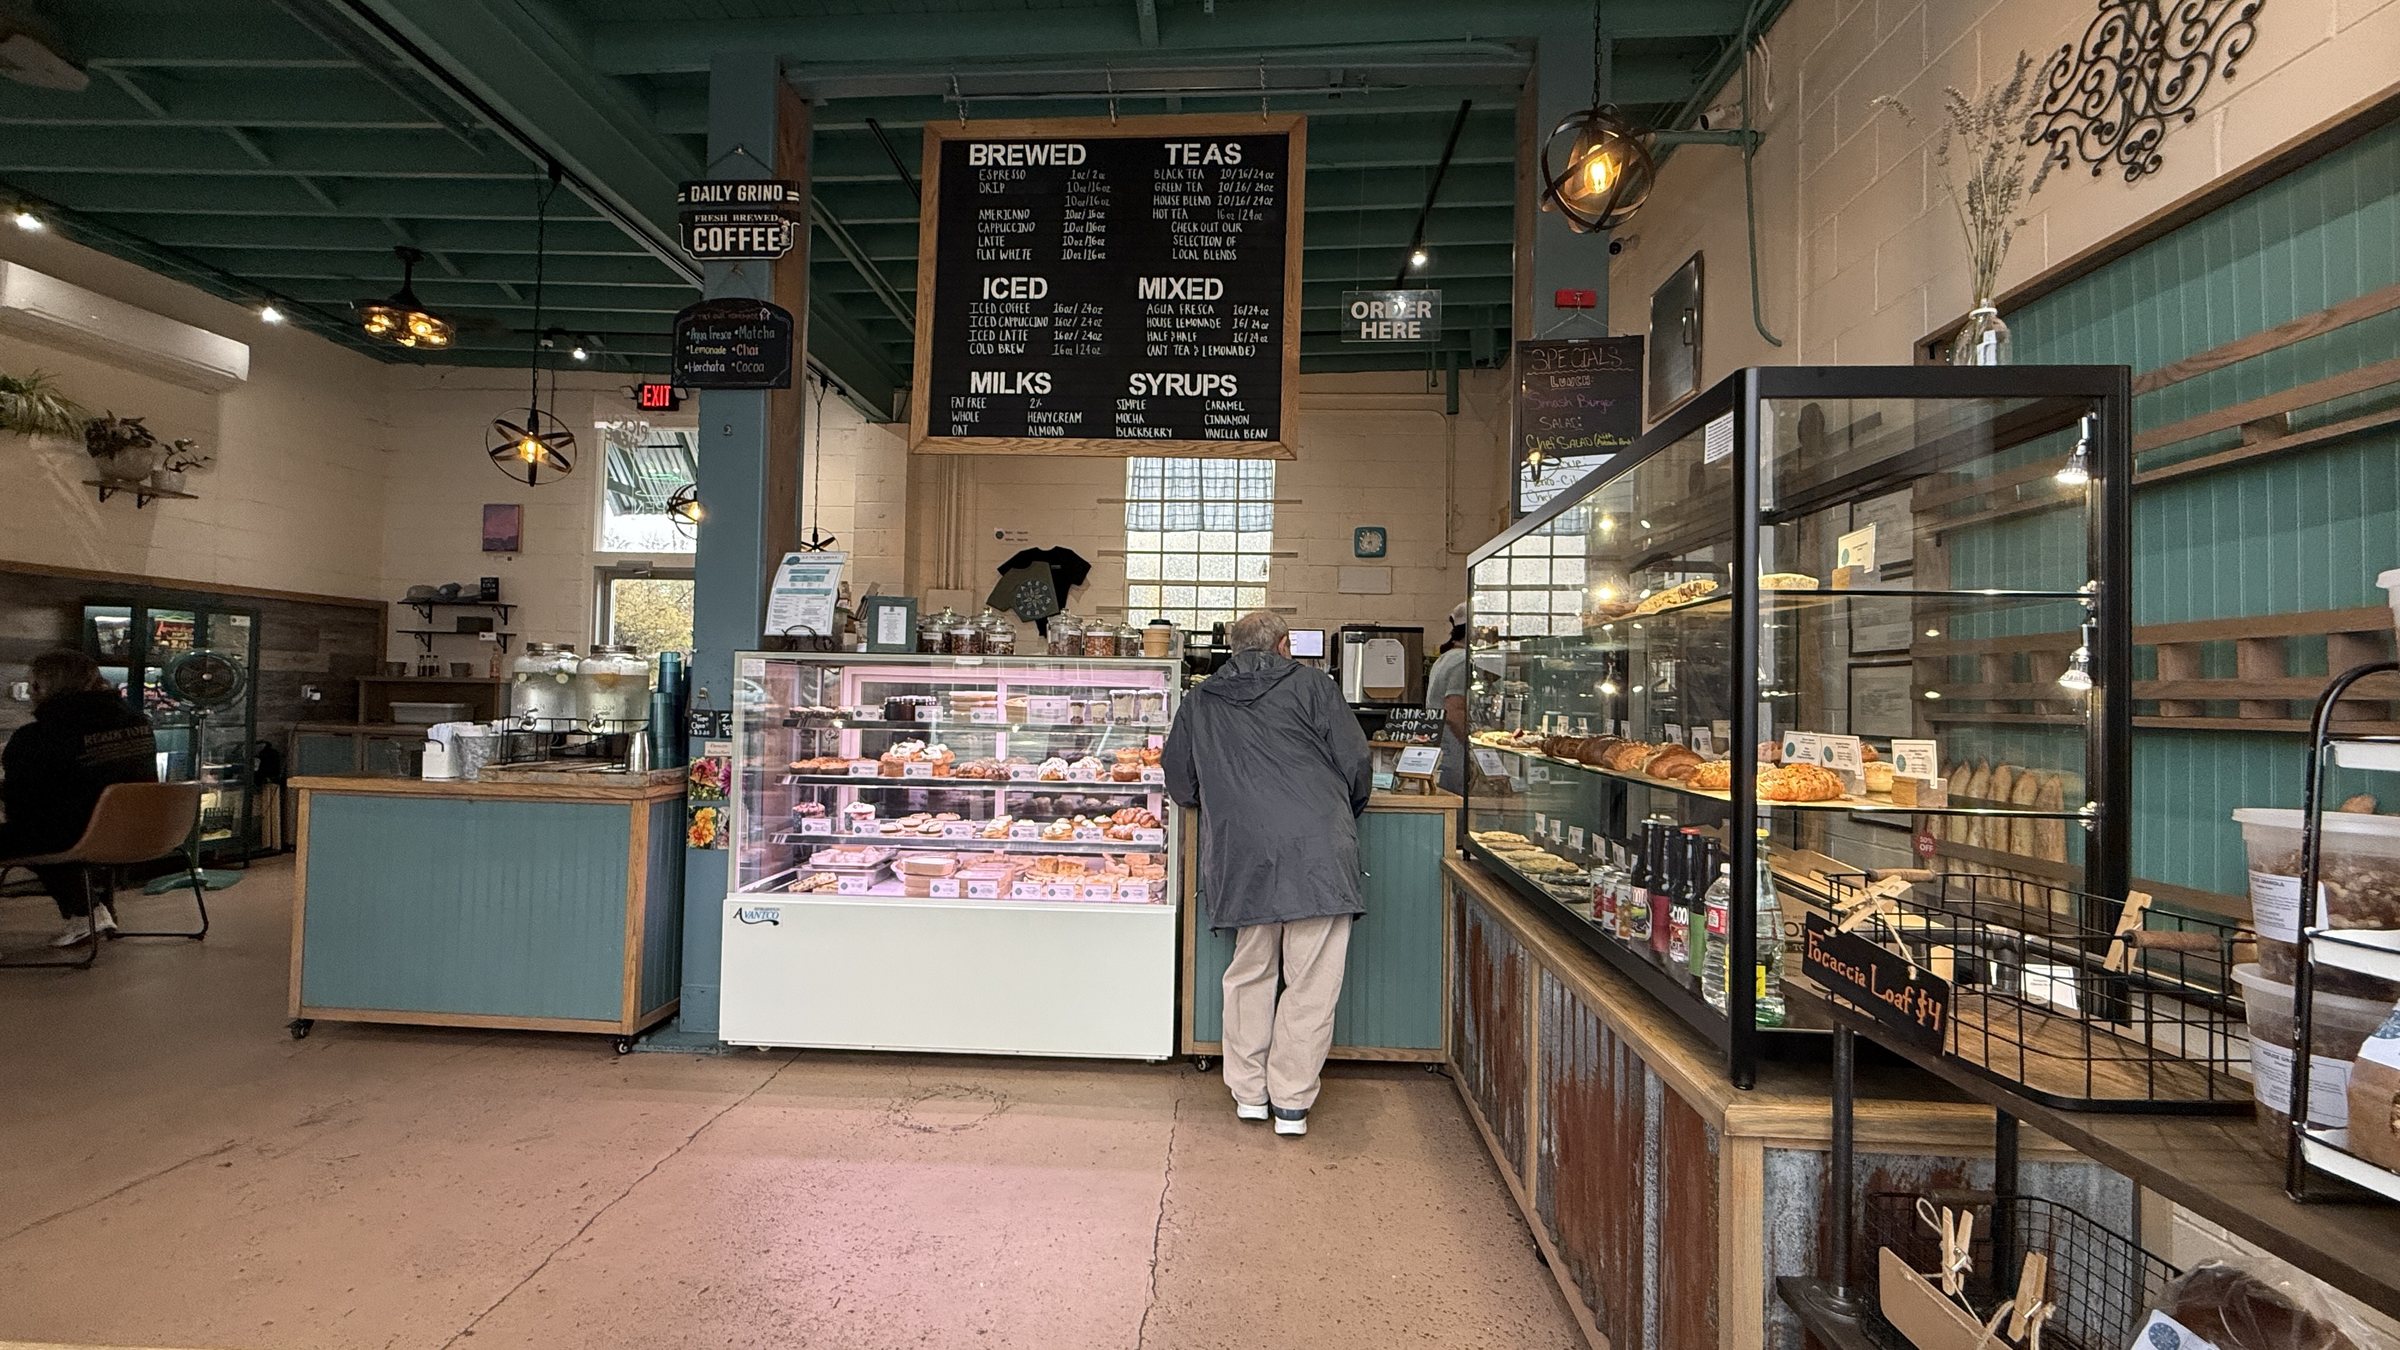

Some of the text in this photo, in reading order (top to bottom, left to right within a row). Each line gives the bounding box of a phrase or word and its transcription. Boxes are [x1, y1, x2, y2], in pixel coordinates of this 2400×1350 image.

[969, 144, 1086, 166] BREWED
[1164, 143, 1242, 165] TEAS
[979, 169, 1026, 180] ESPRESSO
[1154, 169, 1205, 180] BLACK TEA
[979, 182, 1005, 193] DRIP
[1154, 182, 1203, 192] GREEN TEA
[691, 185, 783, 202] DAILY GRIND
[1153, 195, 1211, 207] HOUSE BLEND
[695, 214, 778, 223] FRESH BREWED
[979, 209, 1030, 220] AMERICANO
[1152, 208, 1188, 219] HOT TEA
[978, 222, 1035, 234] CAPPUCCINO
[1171, 221, 1243, 233] CHECK OUT OUR
[693, 227, 780, 252] COFFEE
[978, 235, 1005, 247] LATTE
[1173, 235, 1237, 247] SELECTION OF
[977, 249, 1032, 260] FLAT WHITE
[1172, 248, 1237, 260] LOCAL BLENDS
[983, 277, 1048, 300] ICED
[1139, 277, 1224, 300] MIXED
[969, 303, 1030, 314] ICED COFFEE
[1146, 304, 1214, 315] AGUA FRESCA
[1351, 301, 1432, 319] ORDER
[969, 316, 1049, 328] ICED CAPPUCCINO
[1147, 318, 1221, 329] HOUSE LEMONADE
[739, 325, 775, 340] Matcha
[968, 330, 1028, 342] ICED LATTE
[1361, 321, 1421, 339] HERE
[1147, 331, 1168, 342] HALF
[1176, 332, 1197, 342] HALF
[690, 345, 727, 355] Lemonade
[970, 343, 1025, 355] COLD BREW
[1147, 344, 1168, 357] (ANY
[1173, 344, 1190, 356] TEA
[1202, 345, 1256, 357] LEMONADE)
[1531, 347, 1623, 372] SPECIALS
[688, 360, 725, 373] Horchata
[735, 361, 765, 373] Cocoa
[970, 371, 1052, 394] MILKS
[1128, 373, 1238, 397] SYRUPS
[643, 385, 671, 407] EXIT
[951, 397, 987, 409] FAT FREE
[1116, 399, 1146, 410] SIMPLE
[1205, 400, 1245, 411] CARAMEL
[1577, 393, 1615, 414] Burger
[952, 411, 979, 423] WHOLE
[1115, 413, 1144, 424] MOCHA
[1204, 414, 1249, 425] CINNAMON
[952, 424, 968, 436] OAT
[1028, 426, 1064, 437] ALMOND
[1116, 427, 1172, 438] BLACKBERRY
[1204, 428, 1268, 439] VANILLA BEAN
[1526, 434, 1593, 450] Chef SALAD
[1808, 929, 1942, 1032] Focaccia Loaf $4
